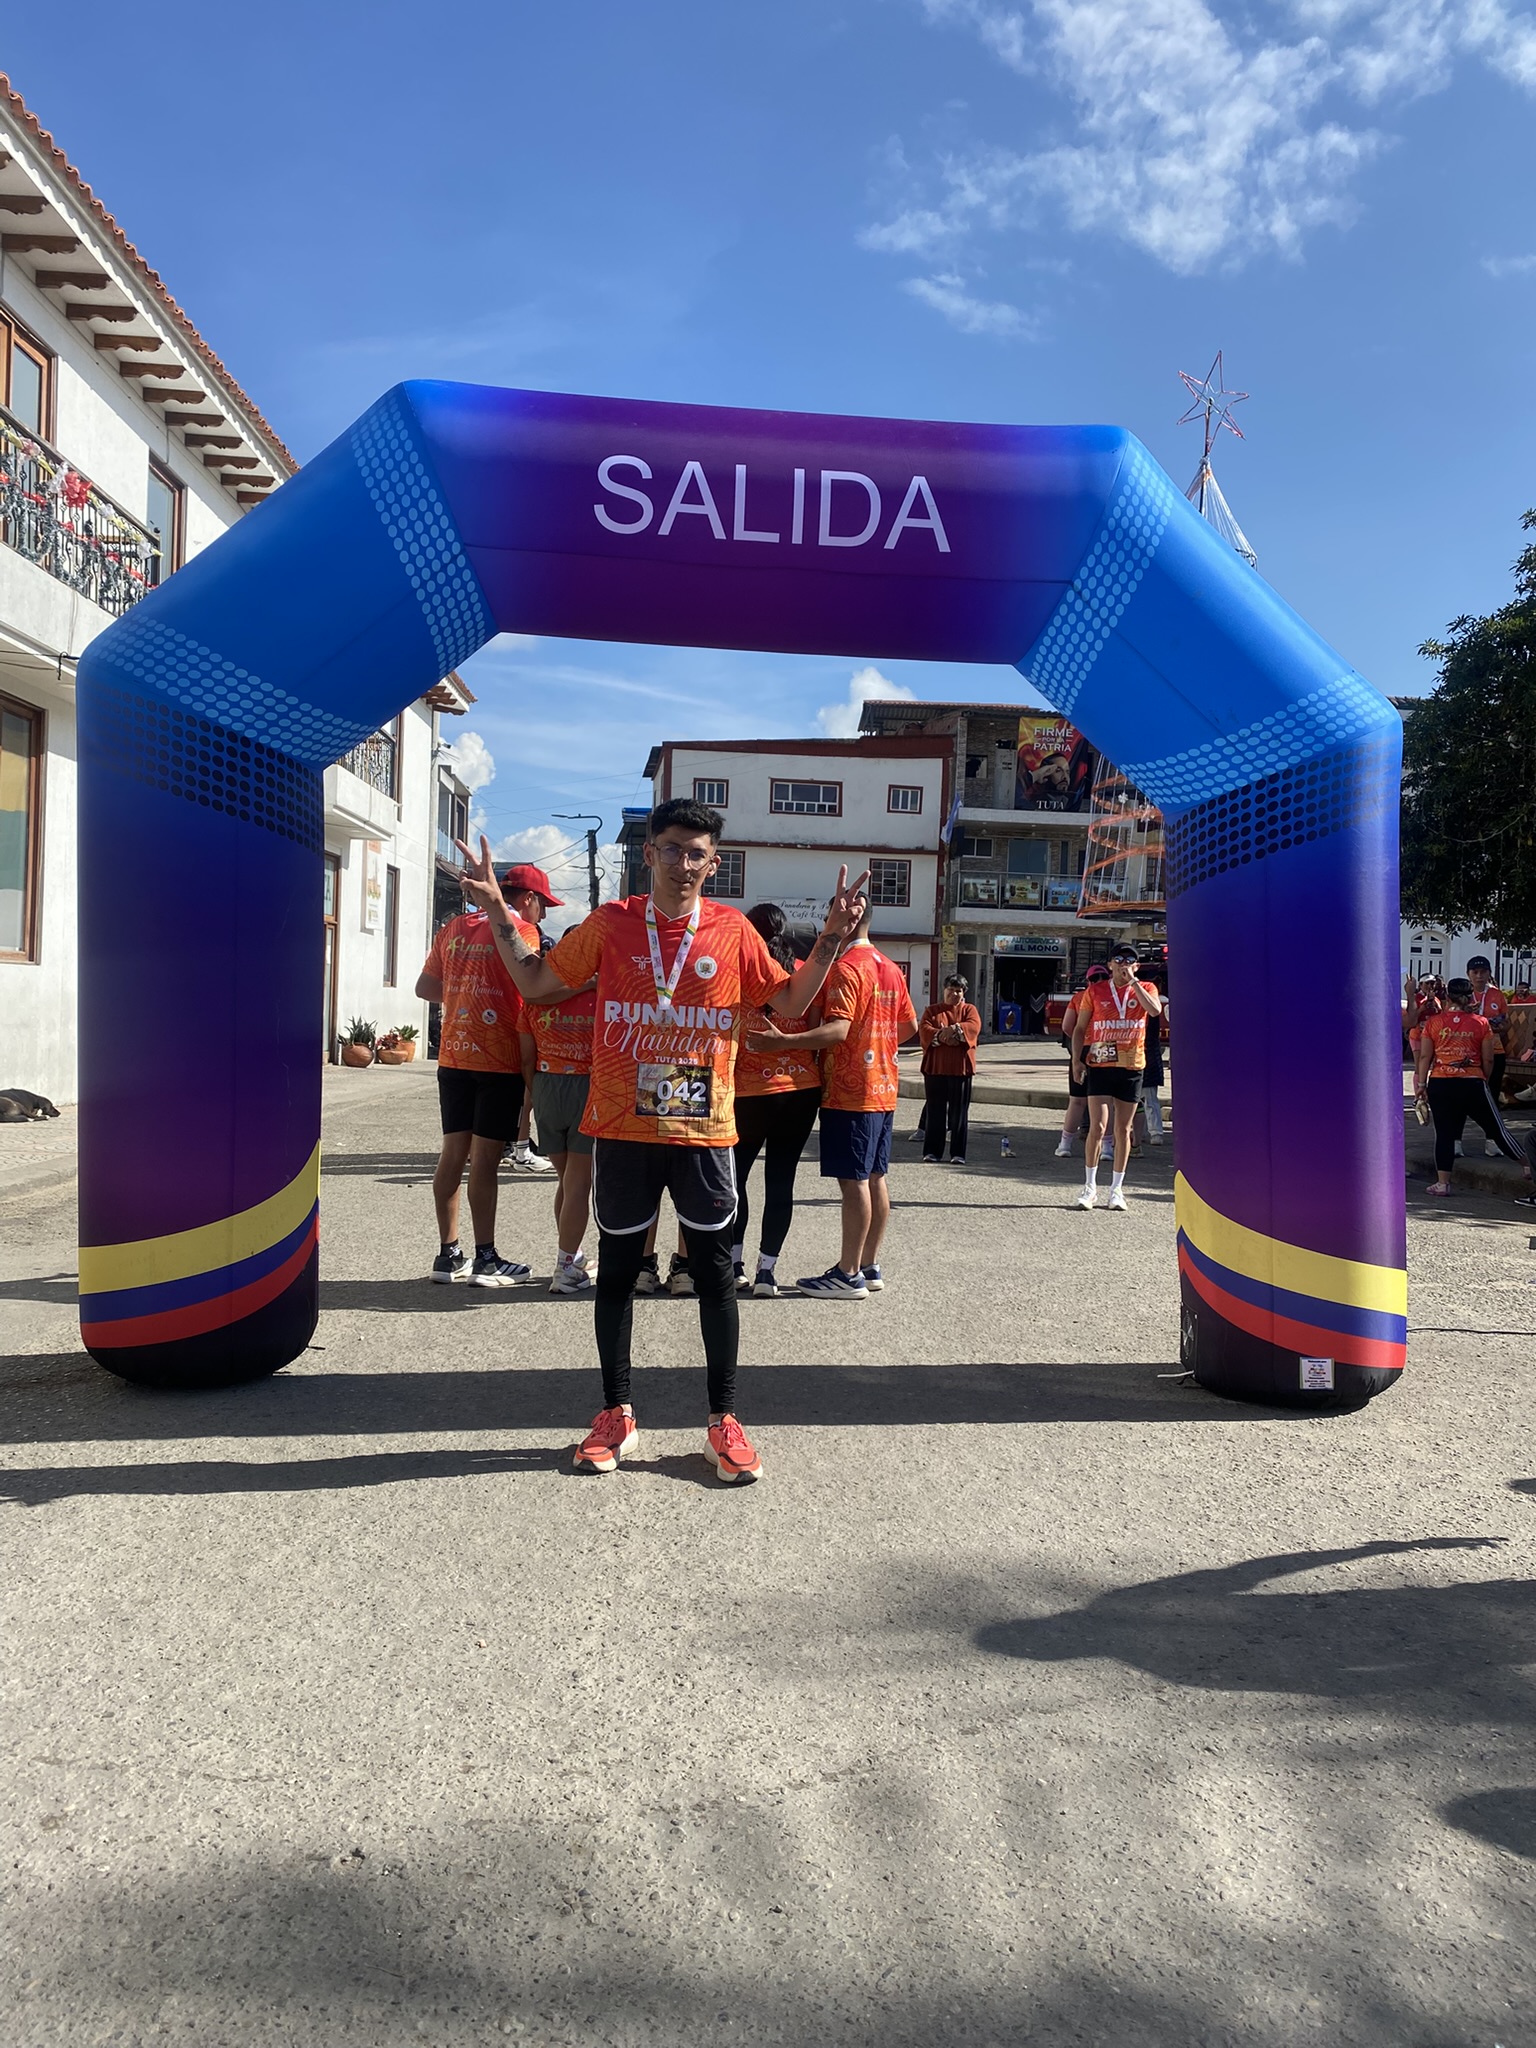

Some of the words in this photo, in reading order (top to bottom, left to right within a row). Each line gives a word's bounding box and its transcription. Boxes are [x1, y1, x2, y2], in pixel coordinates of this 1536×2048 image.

[593, 454, 952, 553] SALIDA
[1034, 727, 1074, 738] FIRME
[1033, 742, 1072, 752] PATRIA
[1036, 800, 1064, 810] TUTA
[603, 1000, 733, 1031] RUNNING
[1093, 1019, 1145, 1031] RUNNING
[445, 1040, 481, 1053] COPA
[1095, 1047, 1116, 1057] 055
[655, 1056, 678, 1065] TUTA
[678, 1057, 699, 1065] 2025
[762, 1064, 808, 1079] COPA
[656, 1079, 708, 1103] 042
[872, 1083, 896, 1095] COPA
